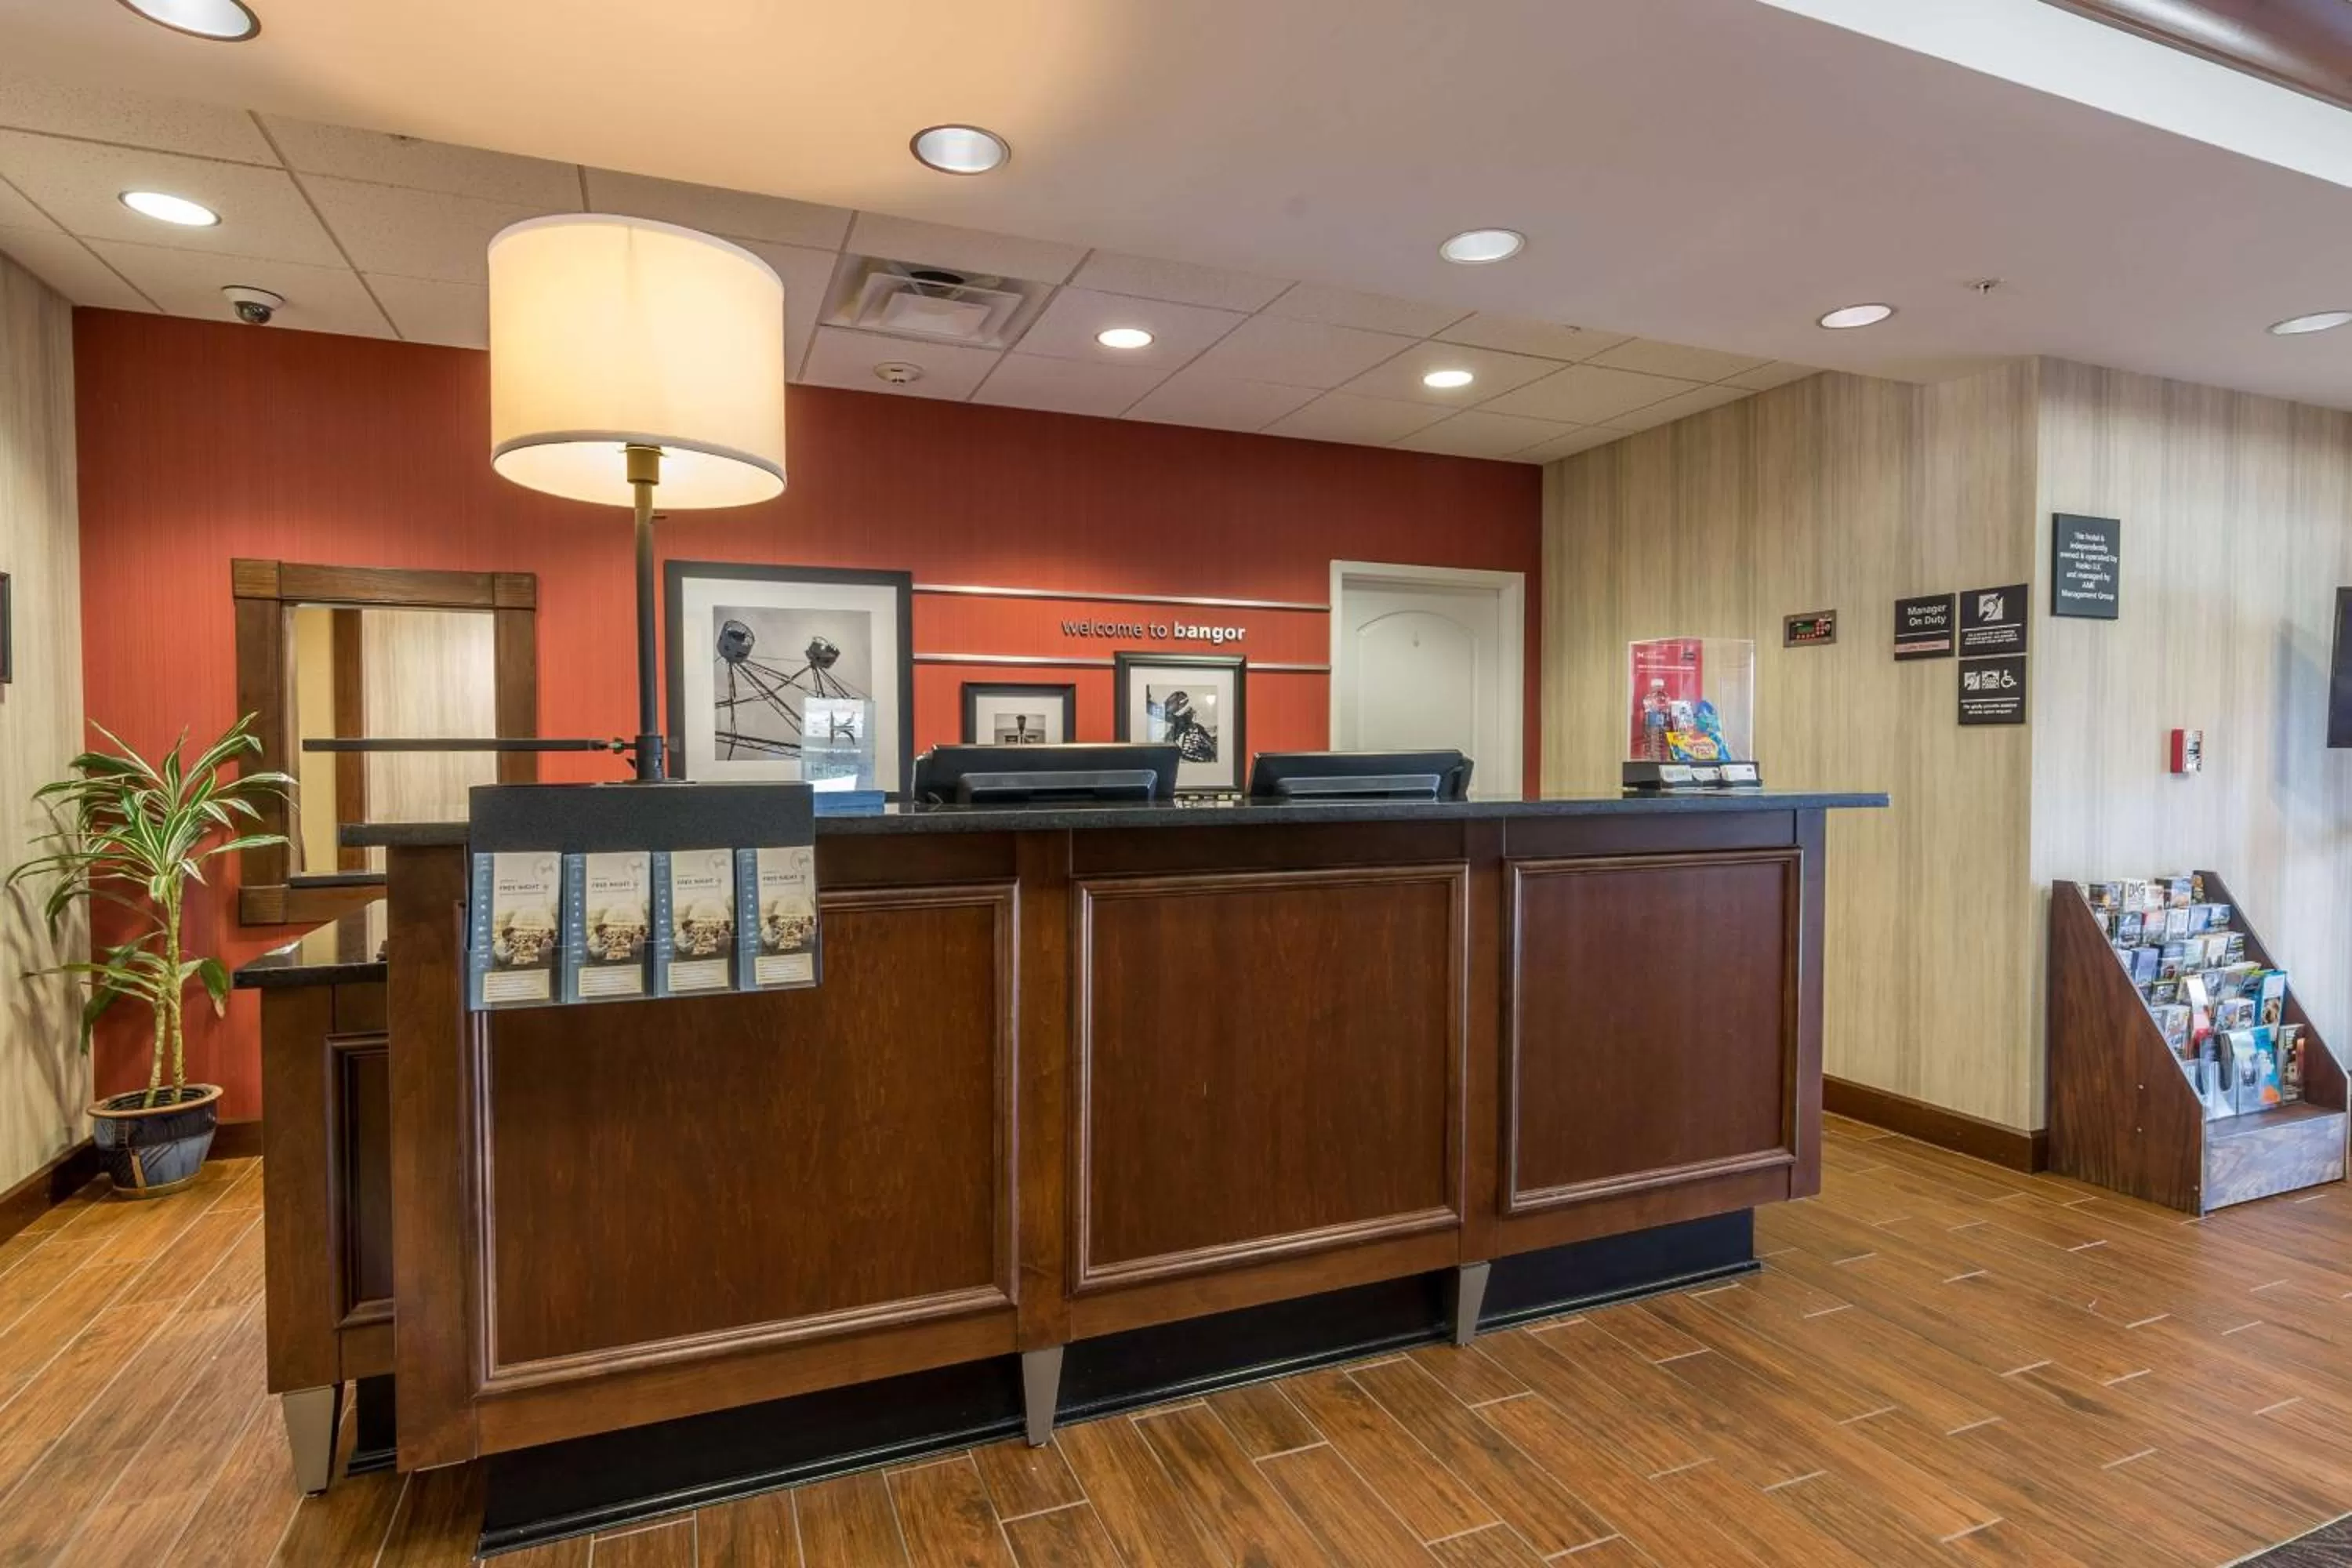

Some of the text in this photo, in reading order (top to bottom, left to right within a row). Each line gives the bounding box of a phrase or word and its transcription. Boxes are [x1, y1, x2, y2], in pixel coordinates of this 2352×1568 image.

[1907, 604, 1947, 615] Manager
[1909, 615, 1947, 626] On Duty
[1062, 619, 1247, 644] welcome to bangor
